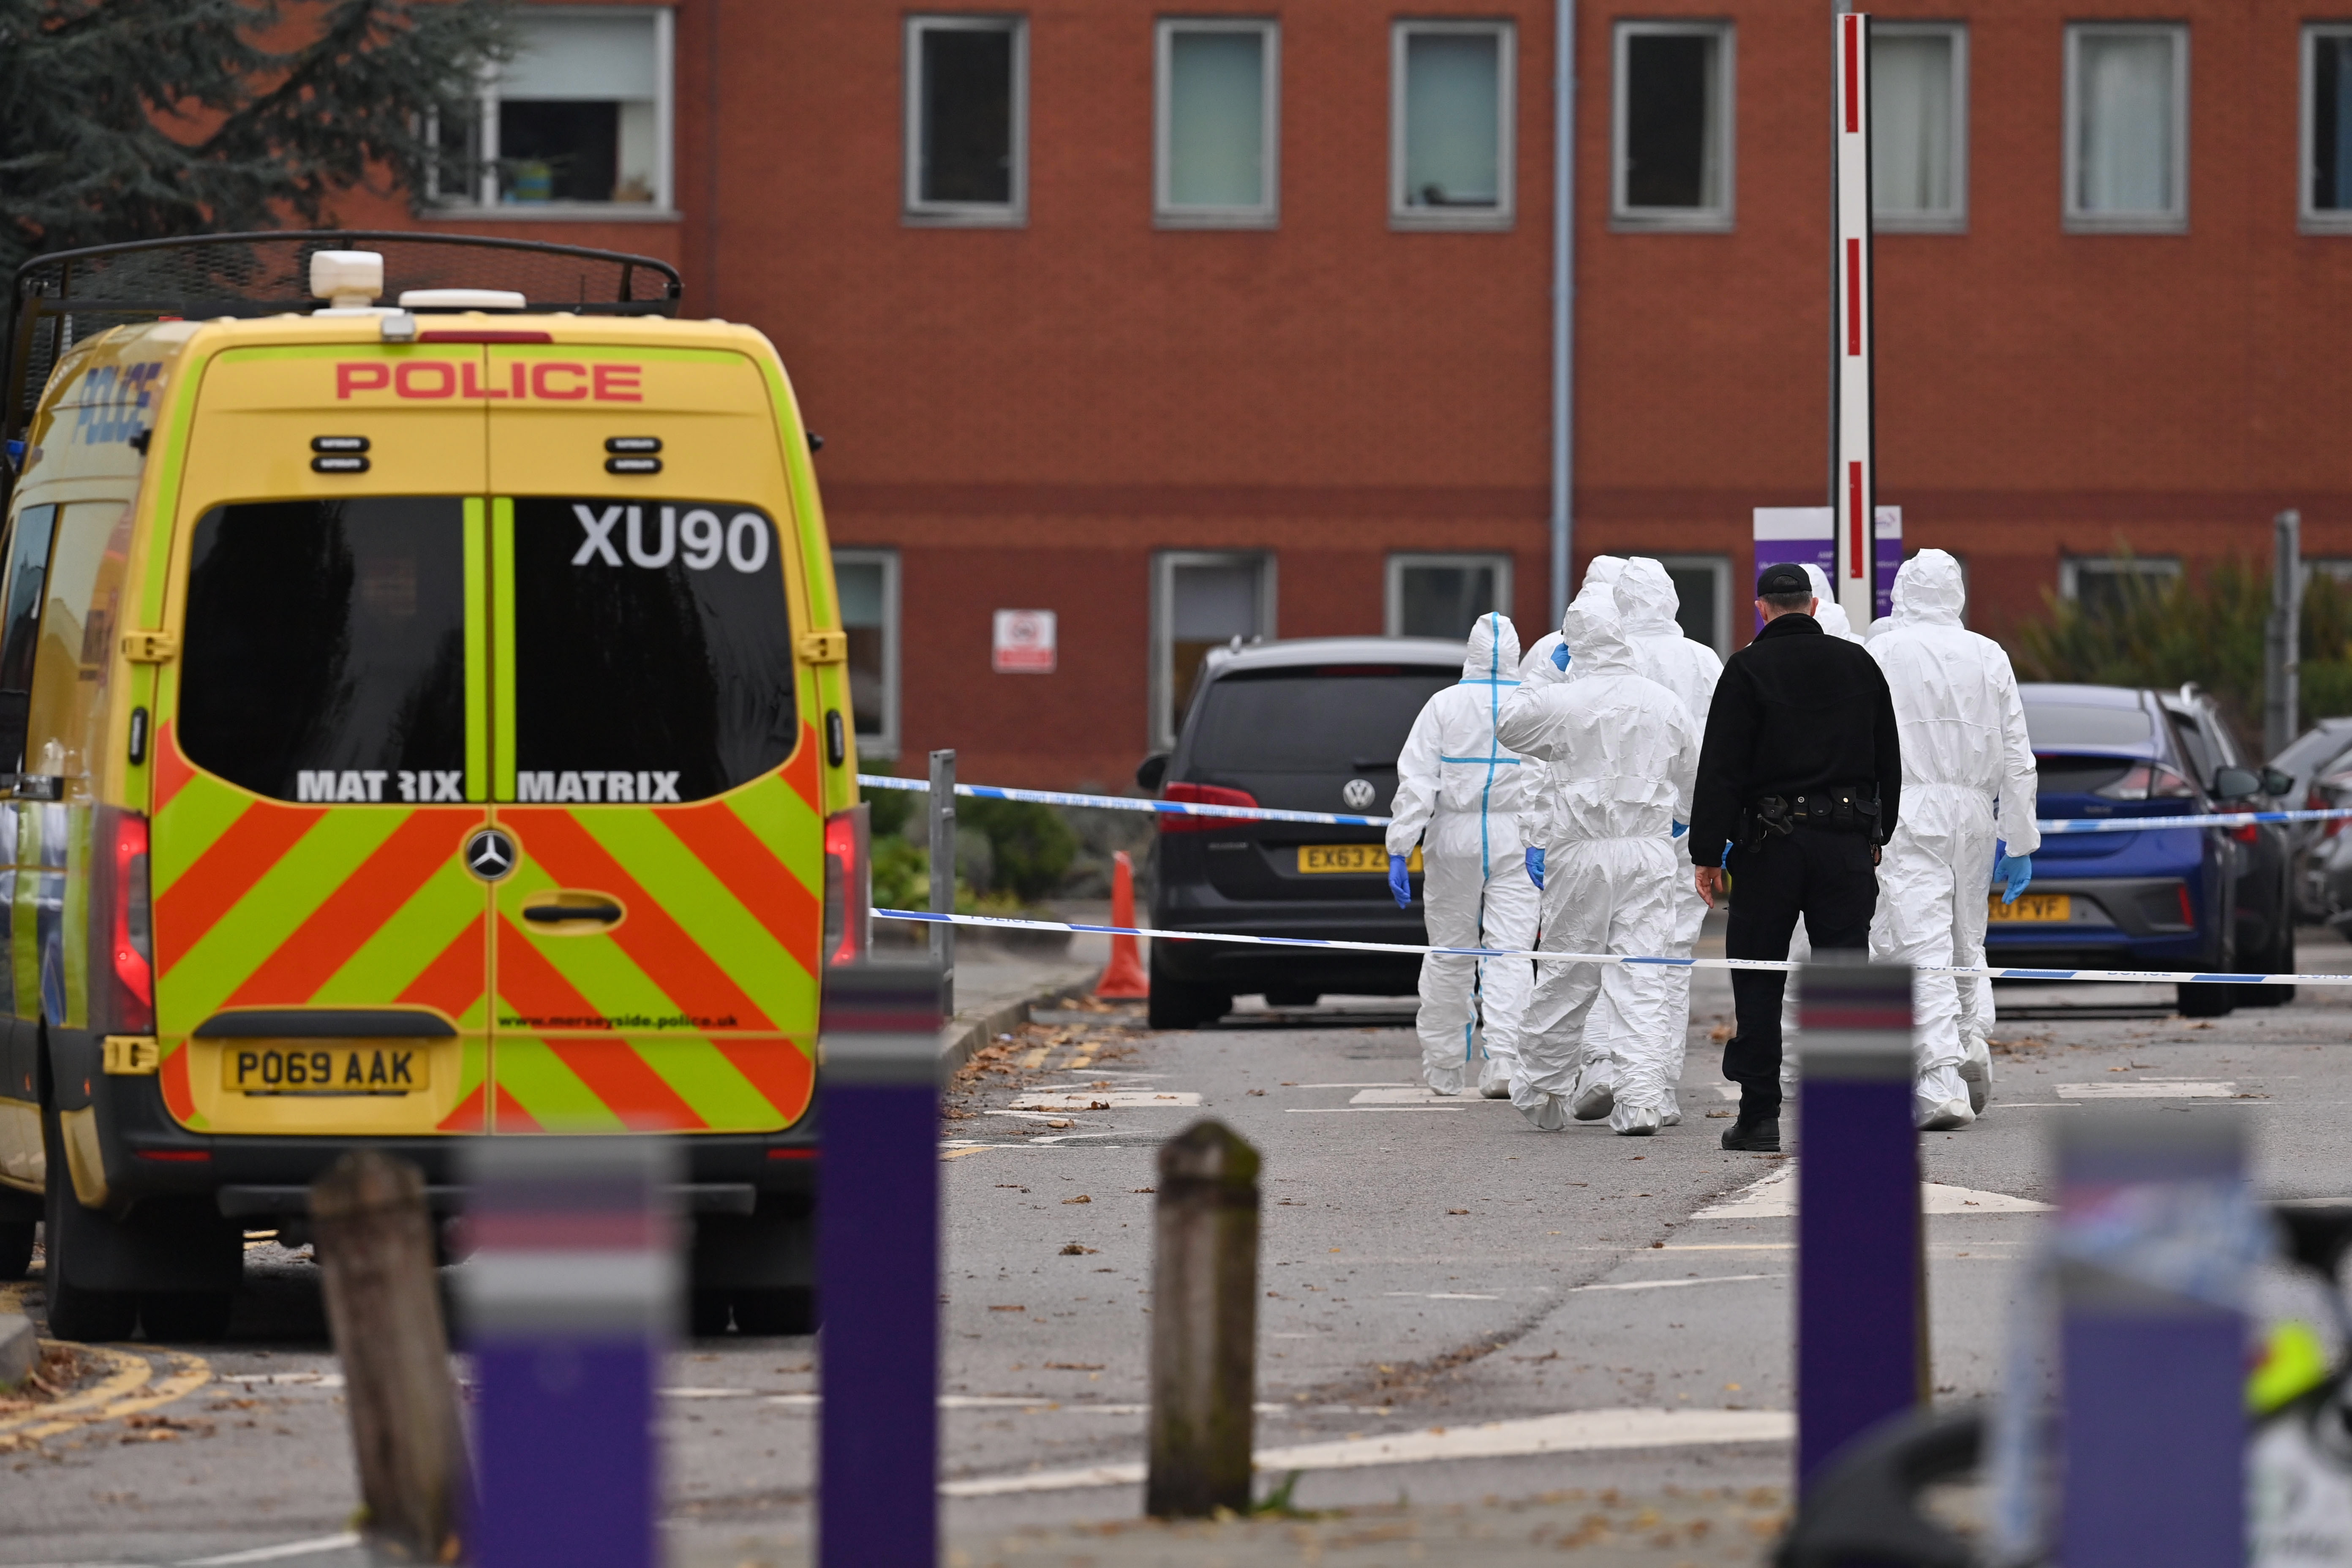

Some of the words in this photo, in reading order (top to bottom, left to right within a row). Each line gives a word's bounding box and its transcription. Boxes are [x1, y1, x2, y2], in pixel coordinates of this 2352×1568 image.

[336, 361, 643, 402] POLICE
[72, 362, 163, 446] POLICE
[571, 504, 770, 573] XU90
[517, 771, 681, 803] MATRIX
[237, 1051, 332, 1084] PO69
[345, 1051, 413, 1084] AAK
